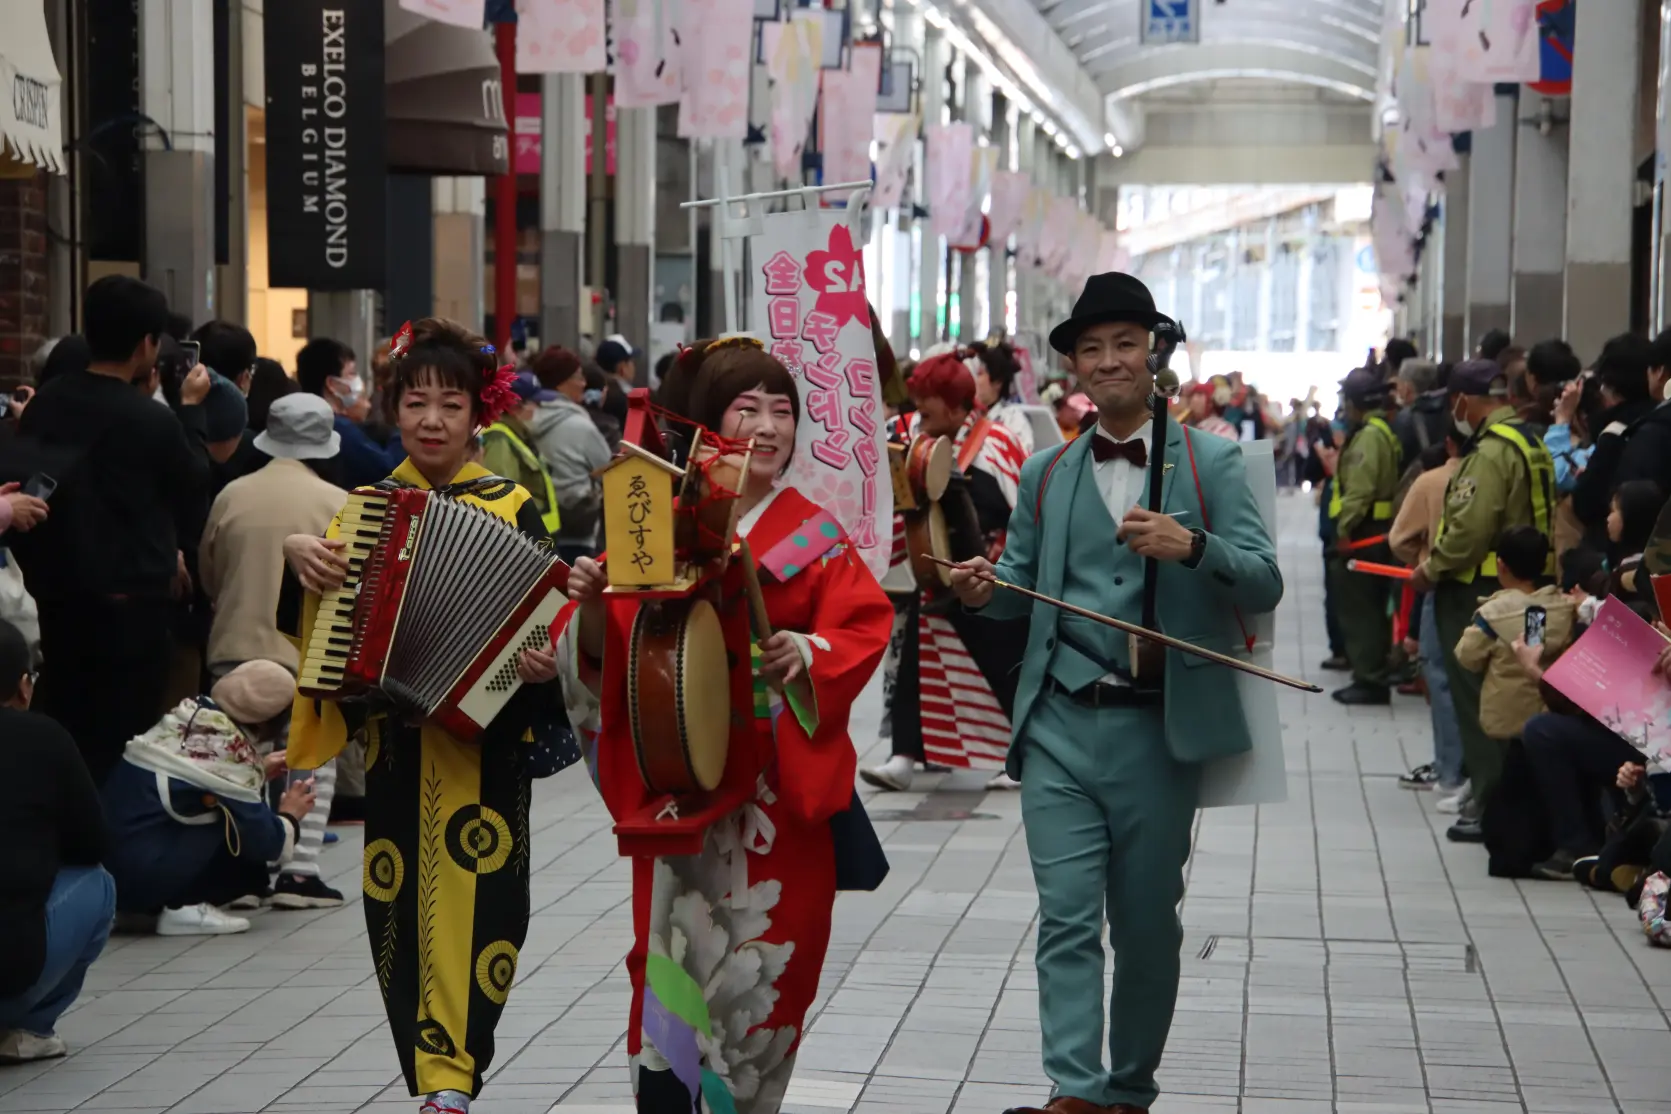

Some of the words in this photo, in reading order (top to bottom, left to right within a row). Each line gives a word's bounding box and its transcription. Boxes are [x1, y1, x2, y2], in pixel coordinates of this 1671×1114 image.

[322, 8, 346, 118] EXELCO
[301, 62, 319, 213] BELGIUM
[324, 126, 348, 268] DIAMOND
[627, 475, 654, 575] ゑびすや
